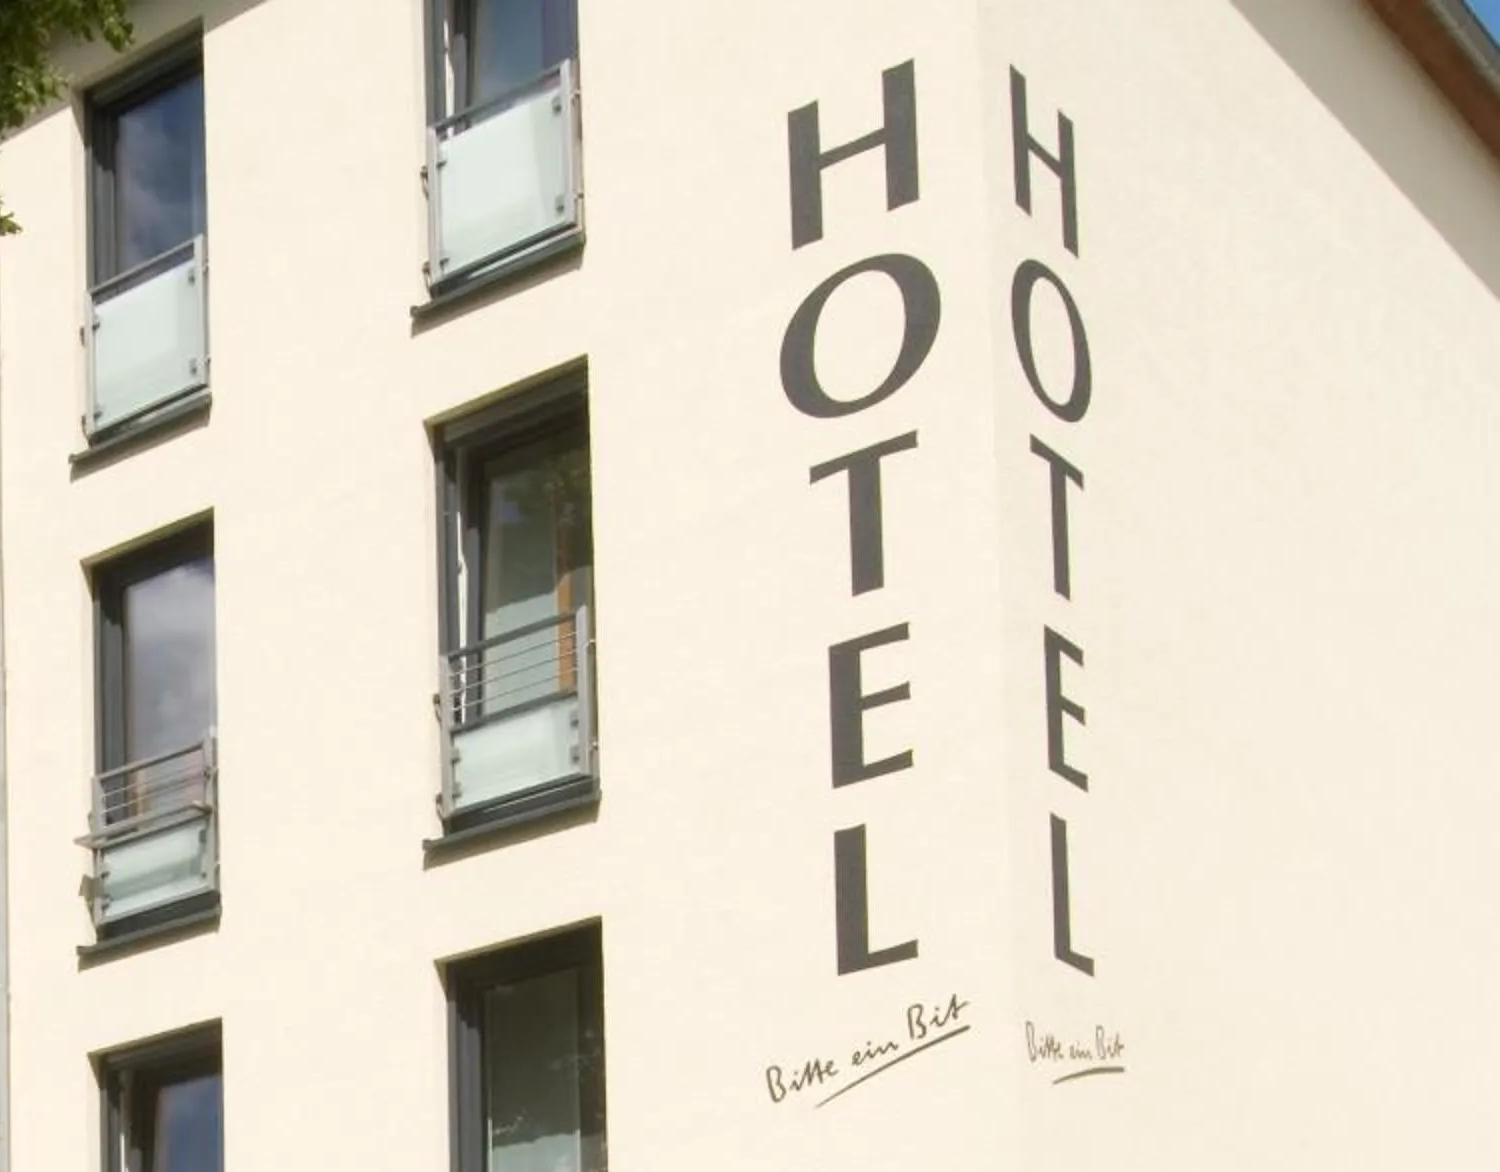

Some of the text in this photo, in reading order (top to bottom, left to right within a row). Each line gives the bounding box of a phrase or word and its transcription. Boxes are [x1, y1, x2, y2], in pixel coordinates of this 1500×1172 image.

[779, 57, 942, 977] HOTEL
[1008, 62, 1095, 978] HOTEL
[765, 993, 971, 1103] Bitte ein Bit
[1025, 1020, 1125, 1062] Bitte ein Bit
